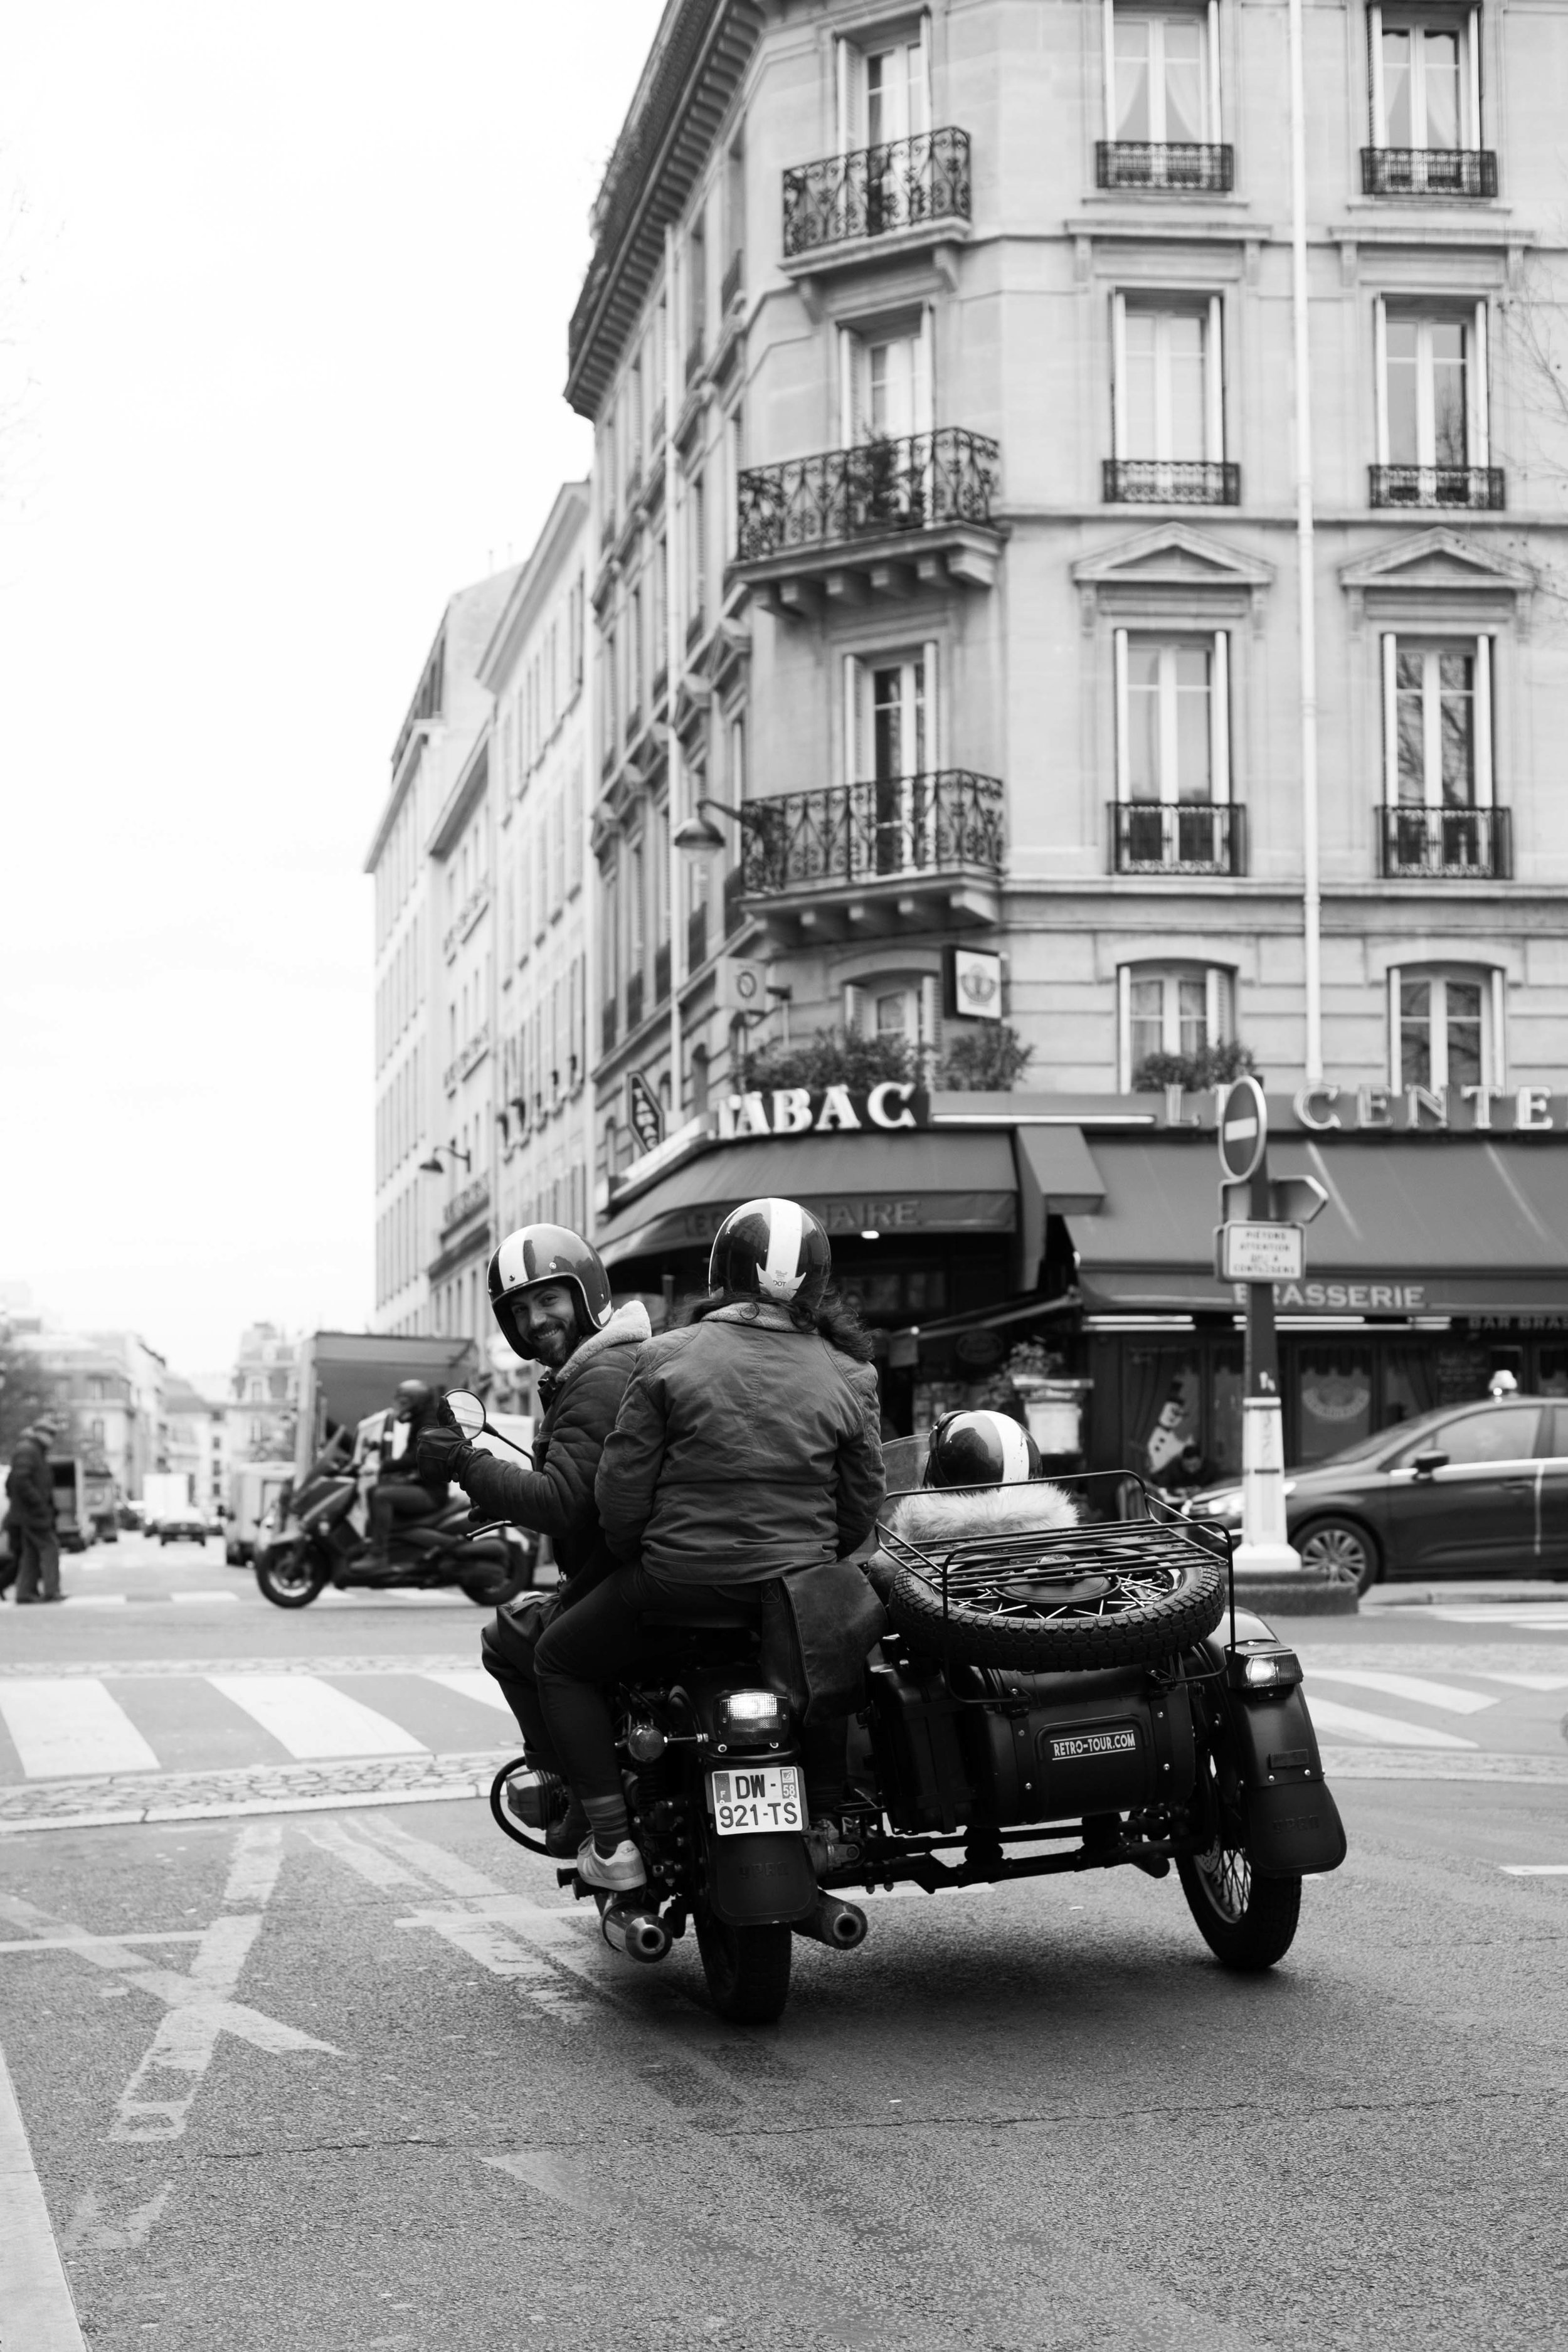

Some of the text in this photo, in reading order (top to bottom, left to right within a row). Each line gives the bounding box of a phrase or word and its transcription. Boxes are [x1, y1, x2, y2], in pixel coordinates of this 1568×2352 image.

[633, 1087, 658, 1150] TABAC
[717, 1081, 917, 1140] TABAC
[1294, 1083, 1568, 1130] CENTE
[1053, 1733, 1136, 1757] RETRO-TOUR.COM
[720, 1790, 726, 1798] F
[783, 1784, 795, 1797] 58
[719, 1802, 798, 1828] 921-TS
